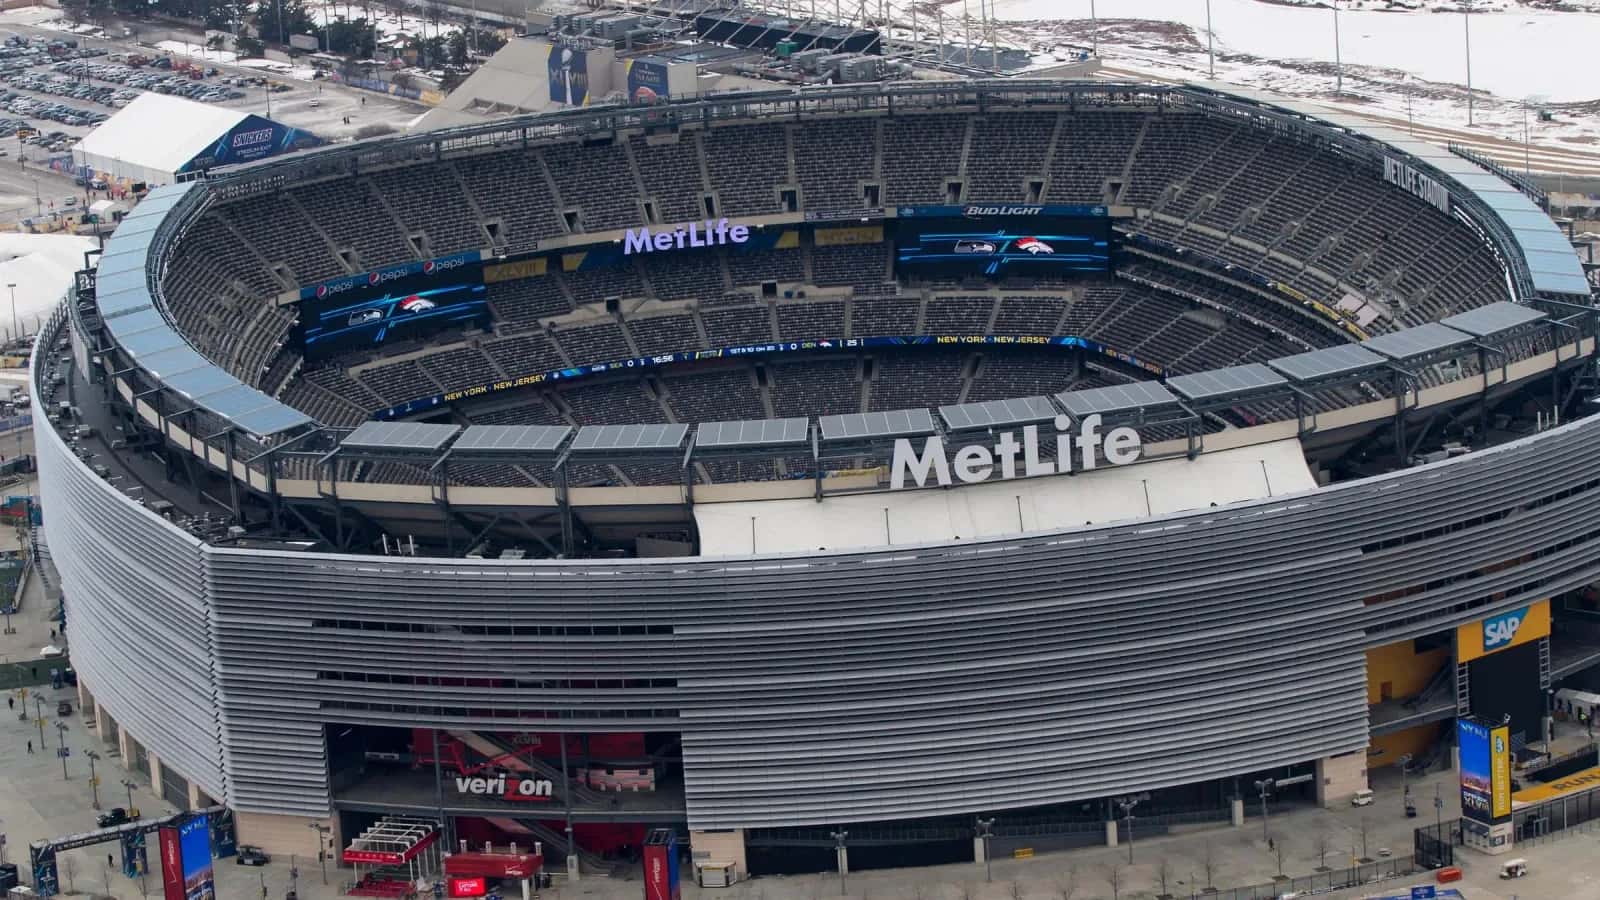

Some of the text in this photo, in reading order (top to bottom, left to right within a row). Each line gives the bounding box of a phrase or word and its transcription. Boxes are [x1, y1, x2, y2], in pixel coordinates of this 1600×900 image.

[967, 205, 1044, 216] BUD LIGHT
[623, 217, 750, 256] MetLife
[380, 266, 409, 282] pepsi
[436, 256, 465, 273] pepsi
[328, 280, 354, 297] pepsi
[1015, 336, 1050, 344] JERSEY
[444, 373, 547, 401] NEW YORK NEW JERSEY
[890, 413, 1141, 489] MetLife
[1485, 617, 1520, 646] SAP
[456, 773, 552, 800] verizon
